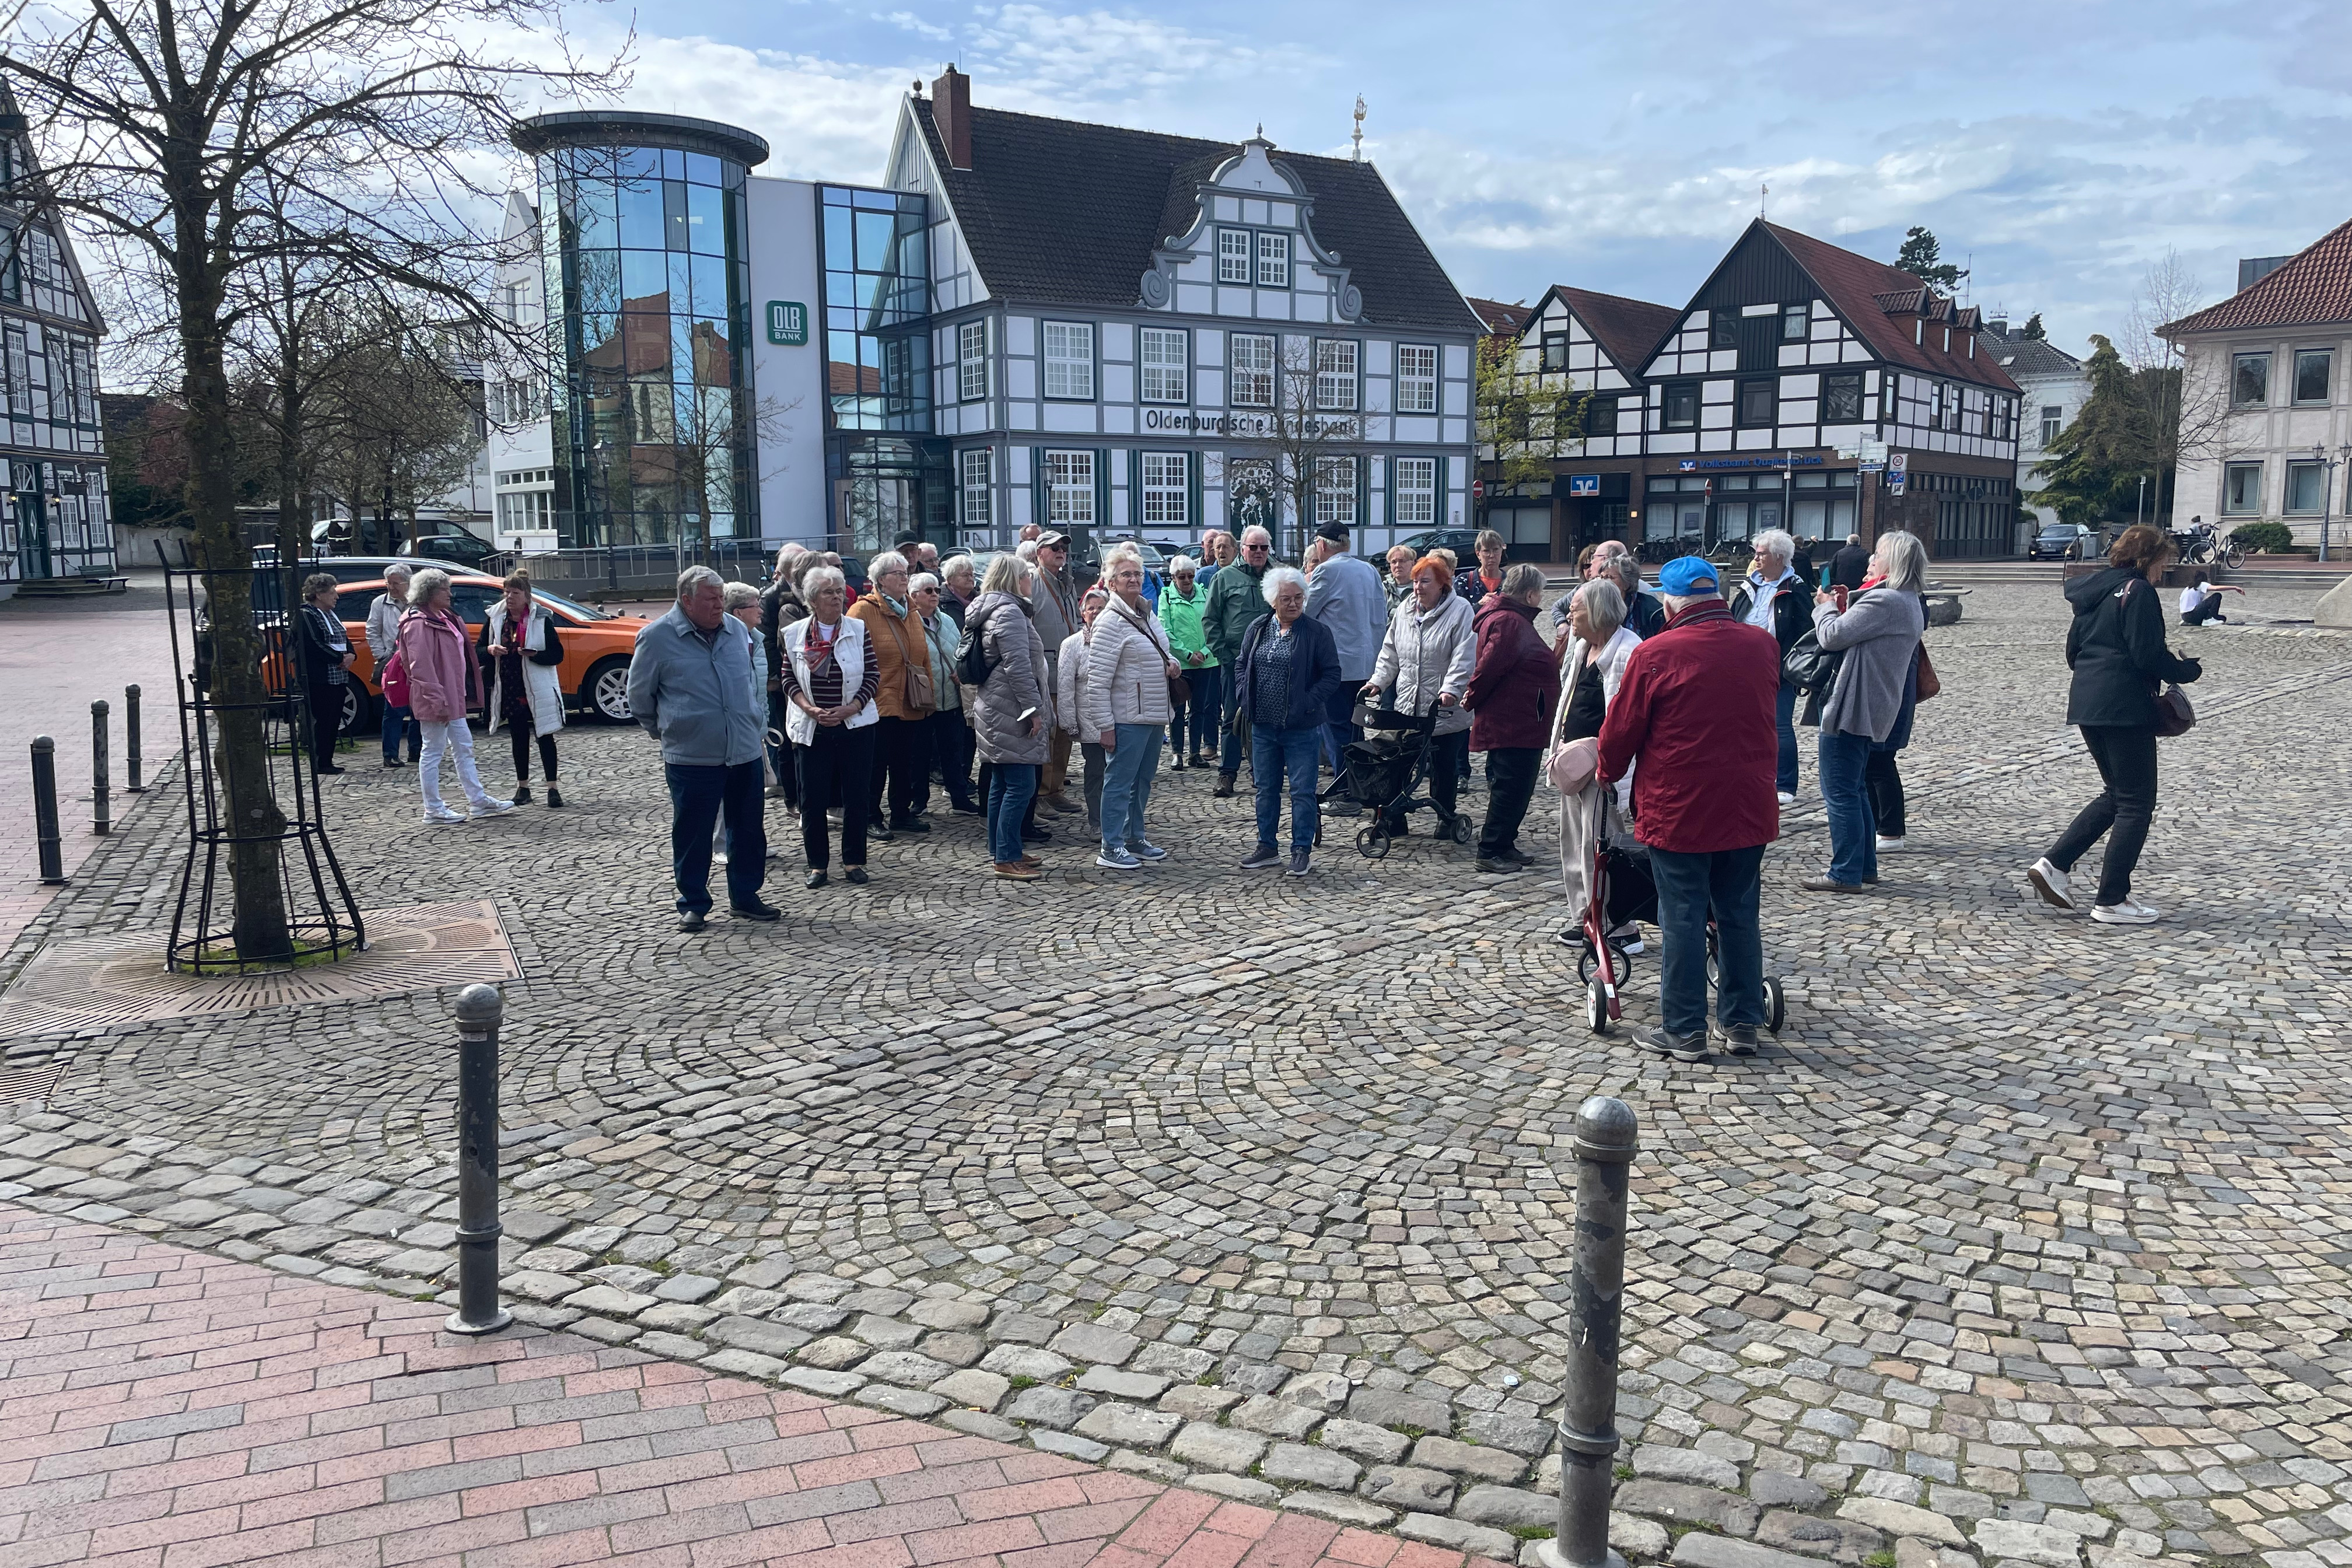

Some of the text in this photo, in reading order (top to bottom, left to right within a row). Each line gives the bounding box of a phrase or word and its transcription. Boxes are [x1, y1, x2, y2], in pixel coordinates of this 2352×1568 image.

[774, 306, 800, 330] OLB
[775, 332, 801, 341] BANK
[1146, 410, 1264, 434] Oldenburgische
[1699, 457, 1751, 468] Volksbank
